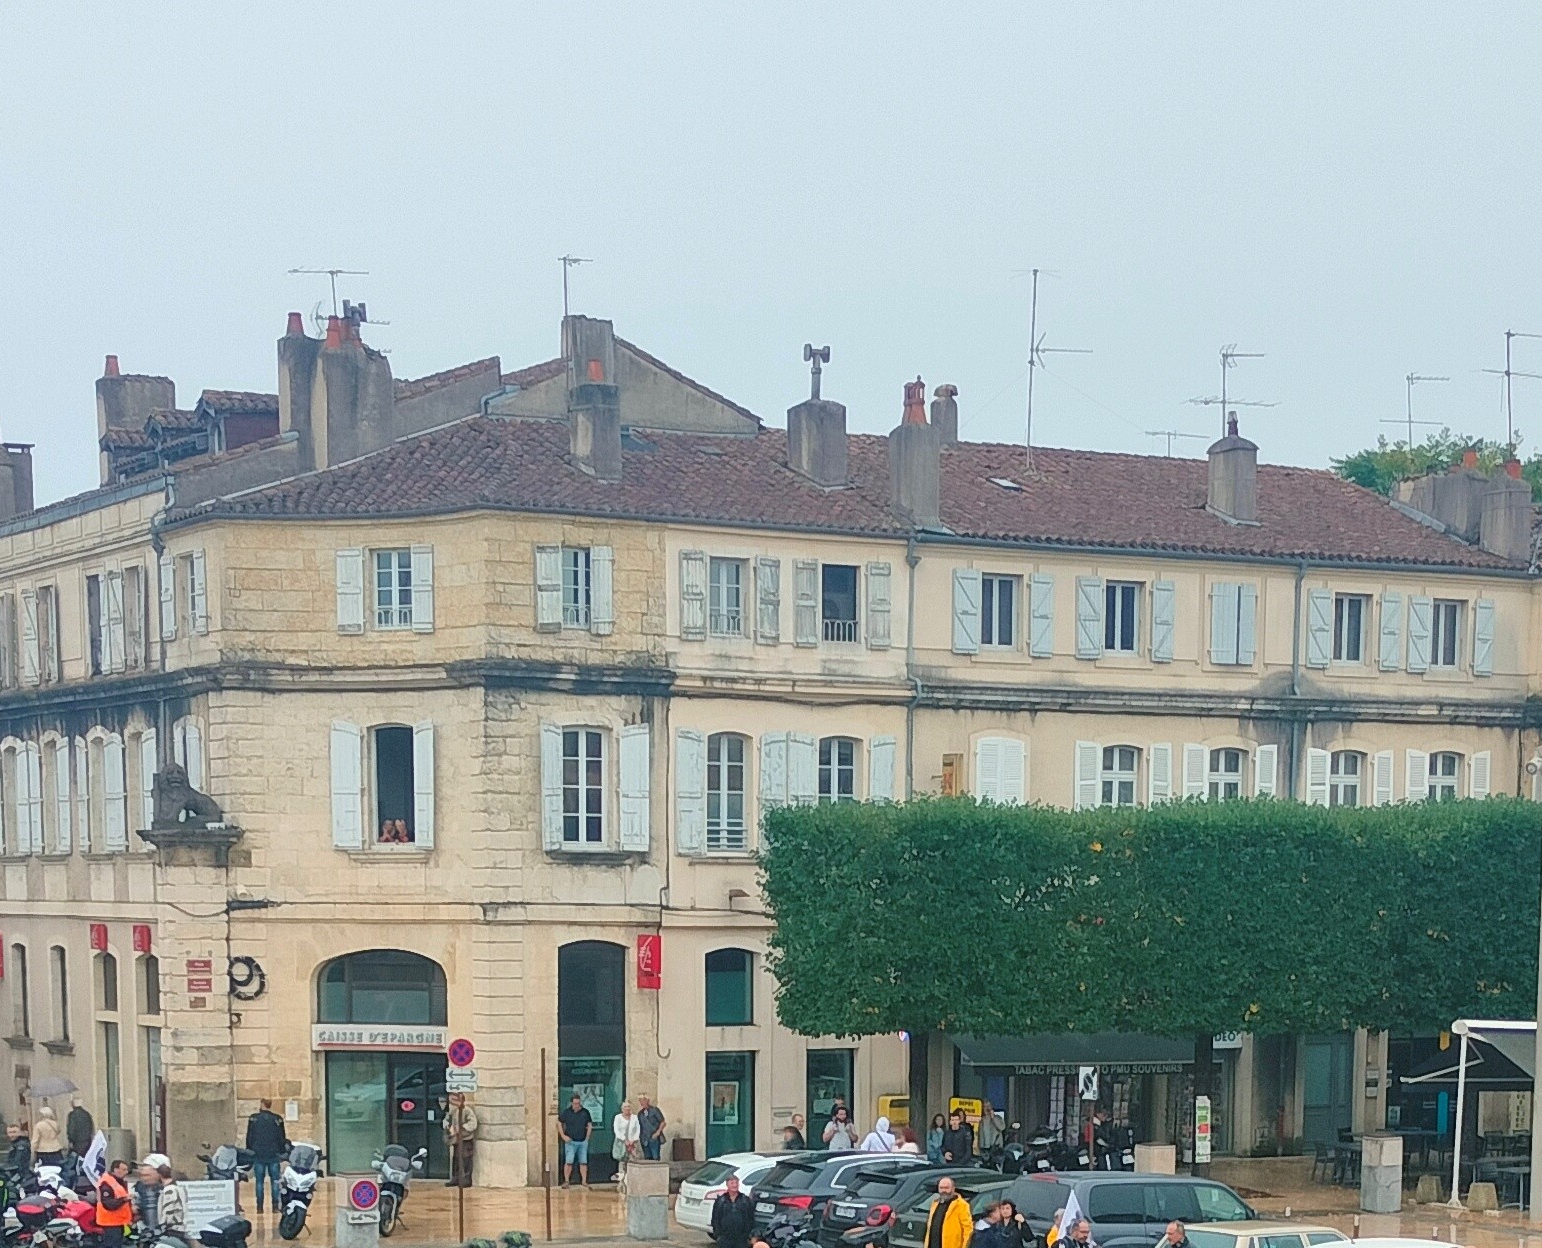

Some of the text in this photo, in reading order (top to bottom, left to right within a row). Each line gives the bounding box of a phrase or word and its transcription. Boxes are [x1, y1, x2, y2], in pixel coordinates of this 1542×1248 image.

[318, 1031, 363, 1043] CAISSE
[1214, 1031, 1236, 1042] DEO
[1015, 1065, 1045, 1075] TABAC
[1110, 1065, 1131, 1075] PMU
[1132, 1063, 1183, 1075] SOUVENIRS
